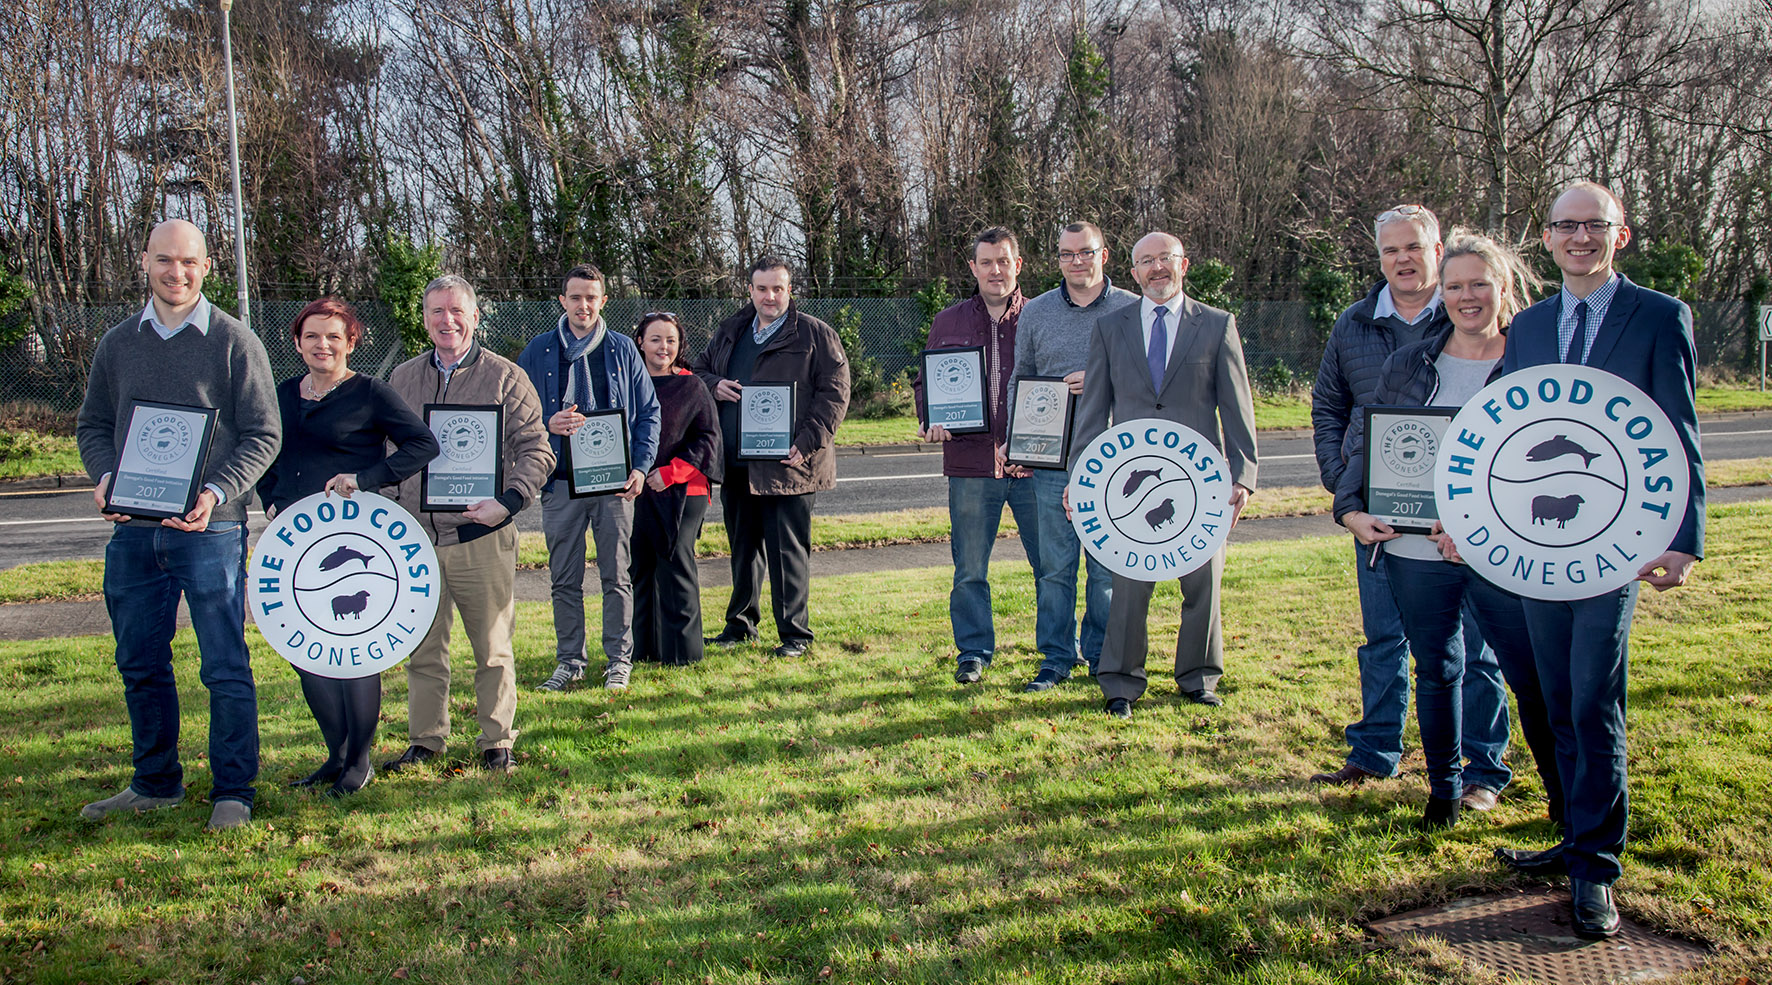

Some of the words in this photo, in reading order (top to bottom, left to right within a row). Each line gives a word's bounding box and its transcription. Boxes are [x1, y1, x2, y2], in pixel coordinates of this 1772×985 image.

[941, 359, 957, 368] FOOD
[959, 361, 971, 378] COAST
[941, 383, 967, 392] DONEGAL
[771, 394, 781, 411] COAST
[1032, 387, 1048, 395] FOOD
[1049, 391, 1058, 410] COAST
[946, 410, 966, 420] 2017
[141, 427, 151, 442] THE
[152, 417, 175, 426] FOOD
[177, 421, 188, 447] COAST
[449, 418, 468, 428] FOOD
[471, 421, 484, 444] COAST
[585, 422, 600, 431] FOOD
[602, 424, 613, 441] COAST
[1385, 437, 1393, 454] THE
[1392, 424, 1417, 434] FOOD
[1419, 428, 1435, 456] COAST
[585, 446, 610, 455] DONEGAL
[756, 439, 775, 447] 2017
[1026, 443, 1046, 452] 2017
[1448, 429, 1485, 500] THE
[1482, 379, 1594, 424] FOOD
[1605, 396, 1673, 520] COAST
[144, 448, 178, 461] DONEGAL
[446, 449, 478, 459] DONEGAL
[1079, 432, 1135, 488] FOOD
[1145, 428, 1222, 483] COAST
[1390, 460, 1428, 473] DONEGAL
[591, 473, 610, 483] 2017
[136, 486, 166, 498] 2017
[448, 483, 474, 494] 2017
[1392, 502, 1422, 514] 2017
[1078, 501, 1109, 550] THE
[1126, 510, 1222, 570] DONEGAL
[259, 555, 284, 616] THE
[276, 501, 359, 547] FOOD
[370, 508, 430, 597] COAST
[1466, 526, 1638, 585] DONEGAL
[287, 622, 415, 666] DONEGAL
